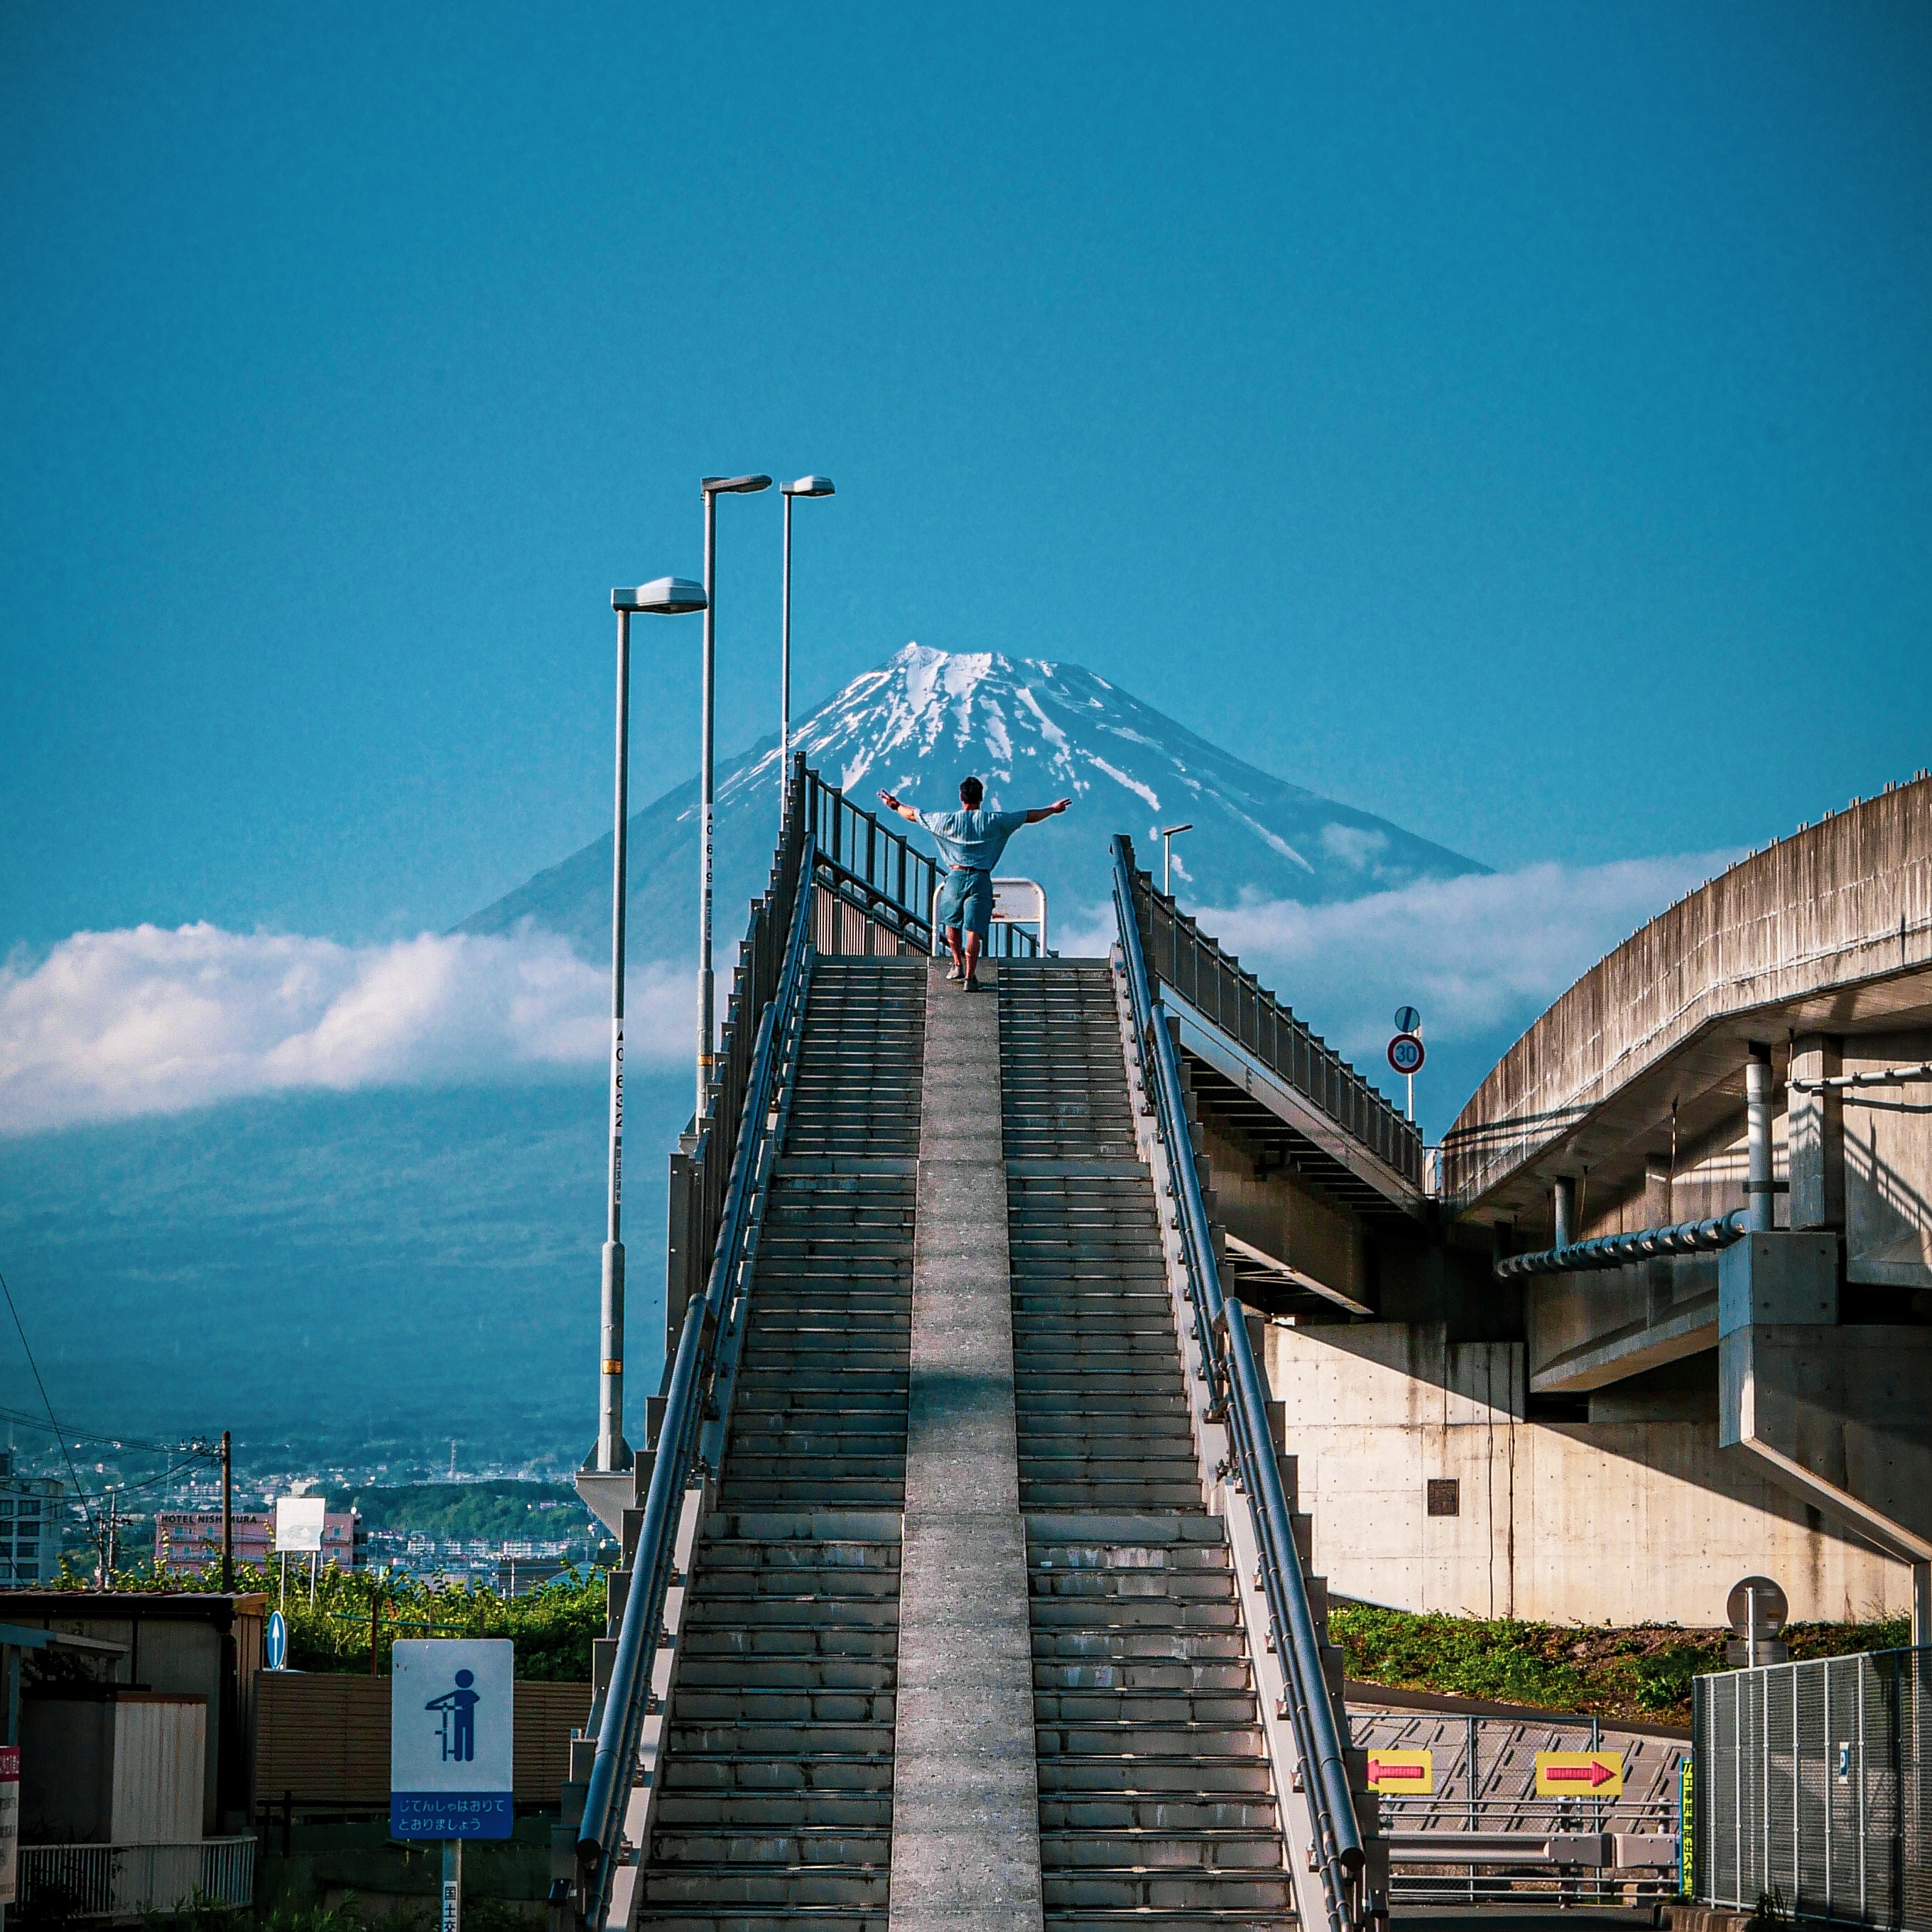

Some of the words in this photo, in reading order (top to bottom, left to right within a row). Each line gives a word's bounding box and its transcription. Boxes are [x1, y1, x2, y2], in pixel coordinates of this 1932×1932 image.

[1395, 1046, 1416, 1063] 30
[161, 1514, 194, 1524] HOTEL
[197, 1514, 257, 1524] NISHMURA
[399, 1799, 505, 1812] じてんしゃはおりて
[398, 1818, 481, 1831] とおりましょう
